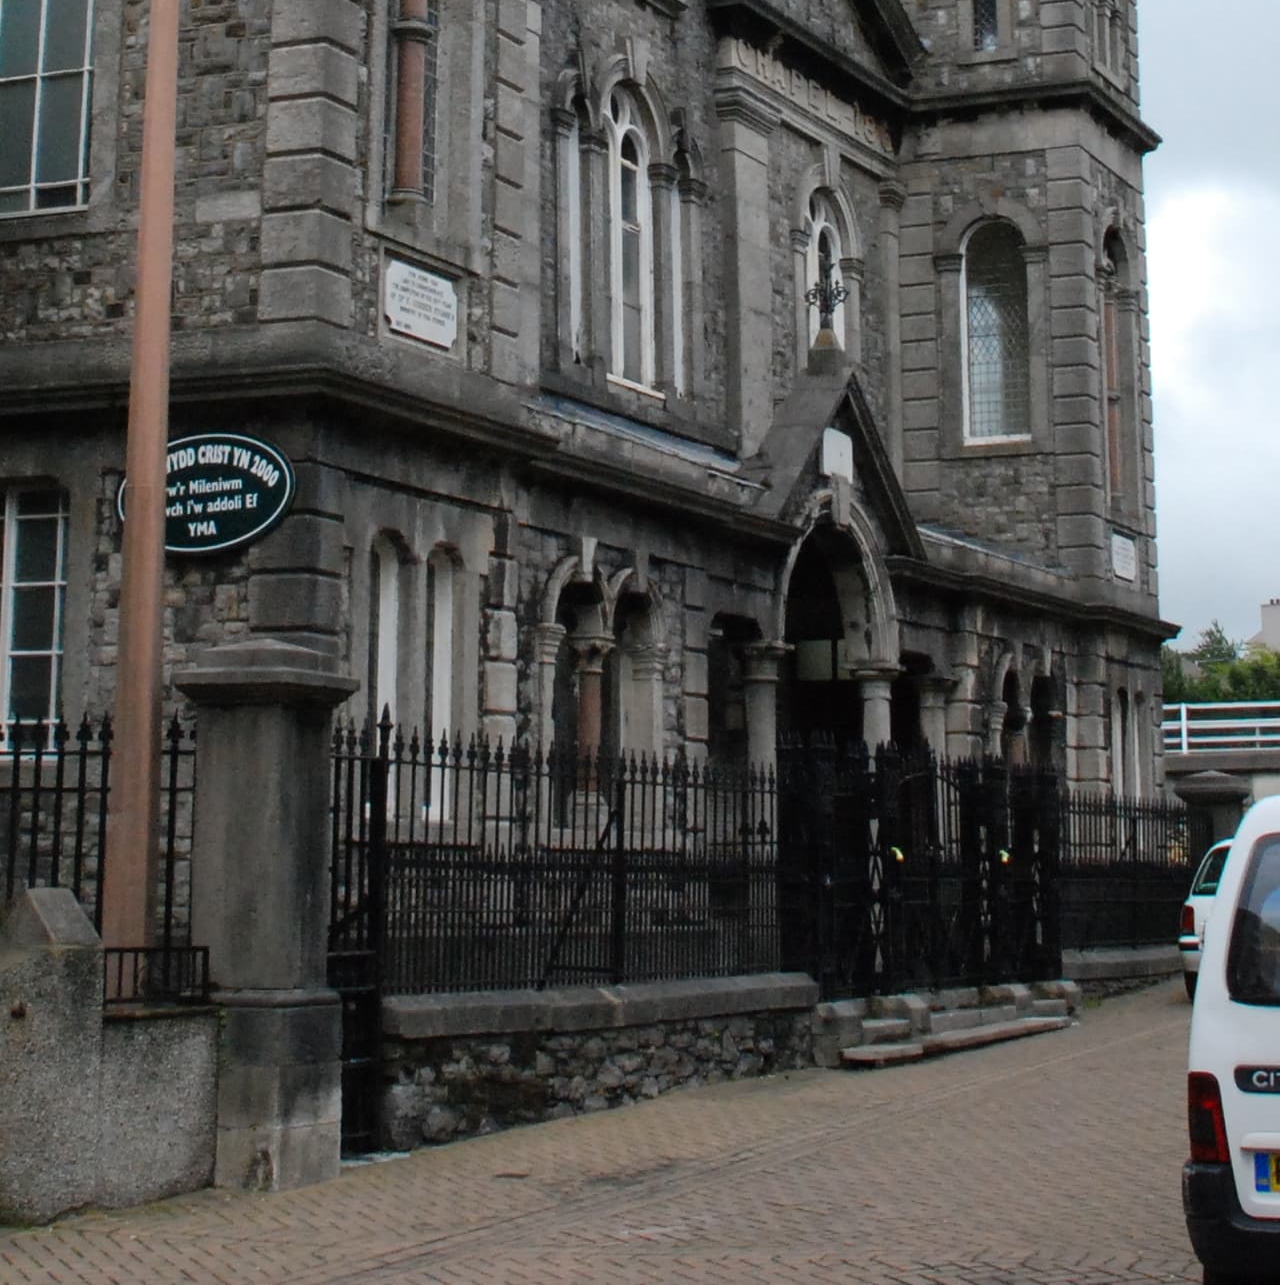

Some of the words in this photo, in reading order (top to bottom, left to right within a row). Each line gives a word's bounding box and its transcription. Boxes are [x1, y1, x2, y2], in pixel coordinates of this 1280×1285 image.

[198, 444, 231, 464] CRIST
[233, 446, 252, 469] YN
[250, 454, 280, 487] 2000
[189, 477, 242, 494] Mileniwm
[207, 494, 242, 512] addoli
[245, 492, 258, 508] Ef
[188, 520, 217, 537] YMA
